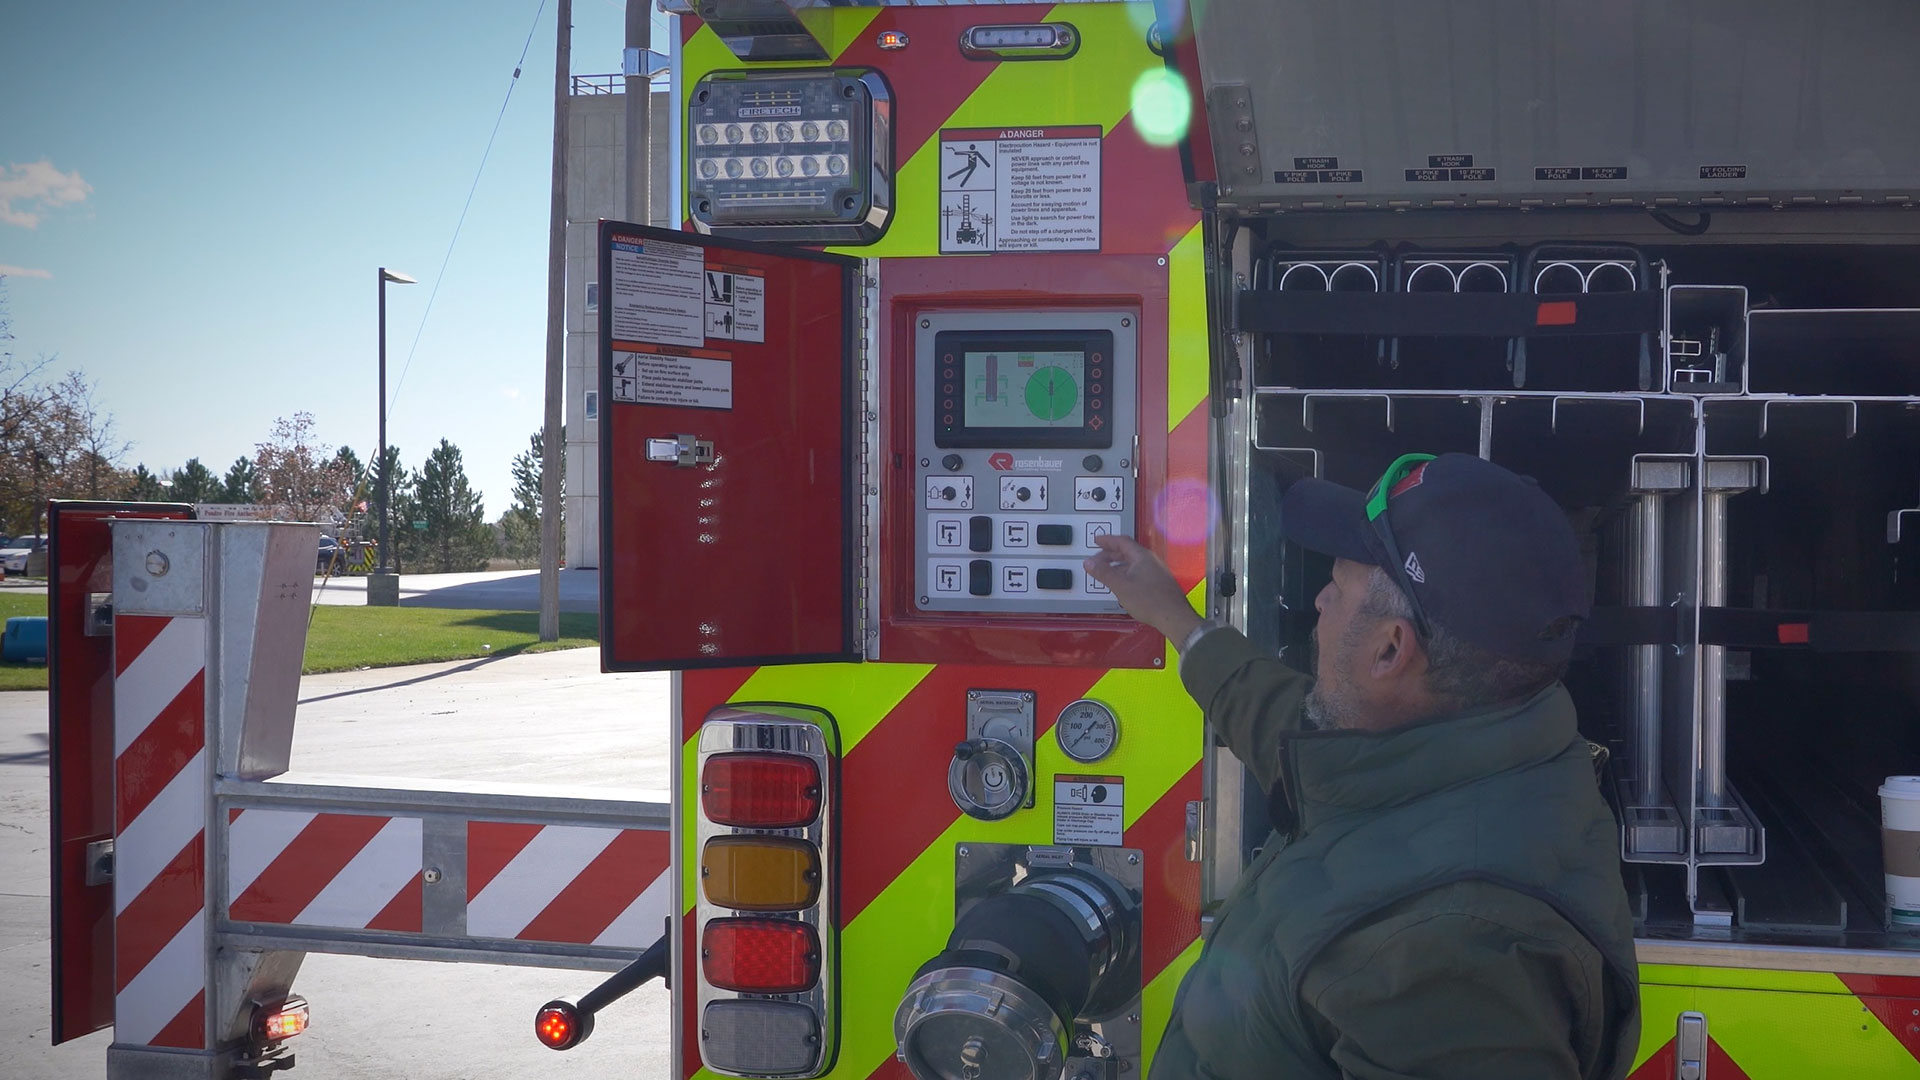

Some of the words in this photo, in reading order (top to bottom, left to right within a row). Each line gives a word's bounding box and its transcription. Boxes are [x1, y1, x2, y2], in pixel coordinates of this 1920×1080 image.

[1008, 130, 1044, 138] DANGER
[618, 236, 643, 245] DANGER
[1015, 456, 1062, 468] rosenbauer
